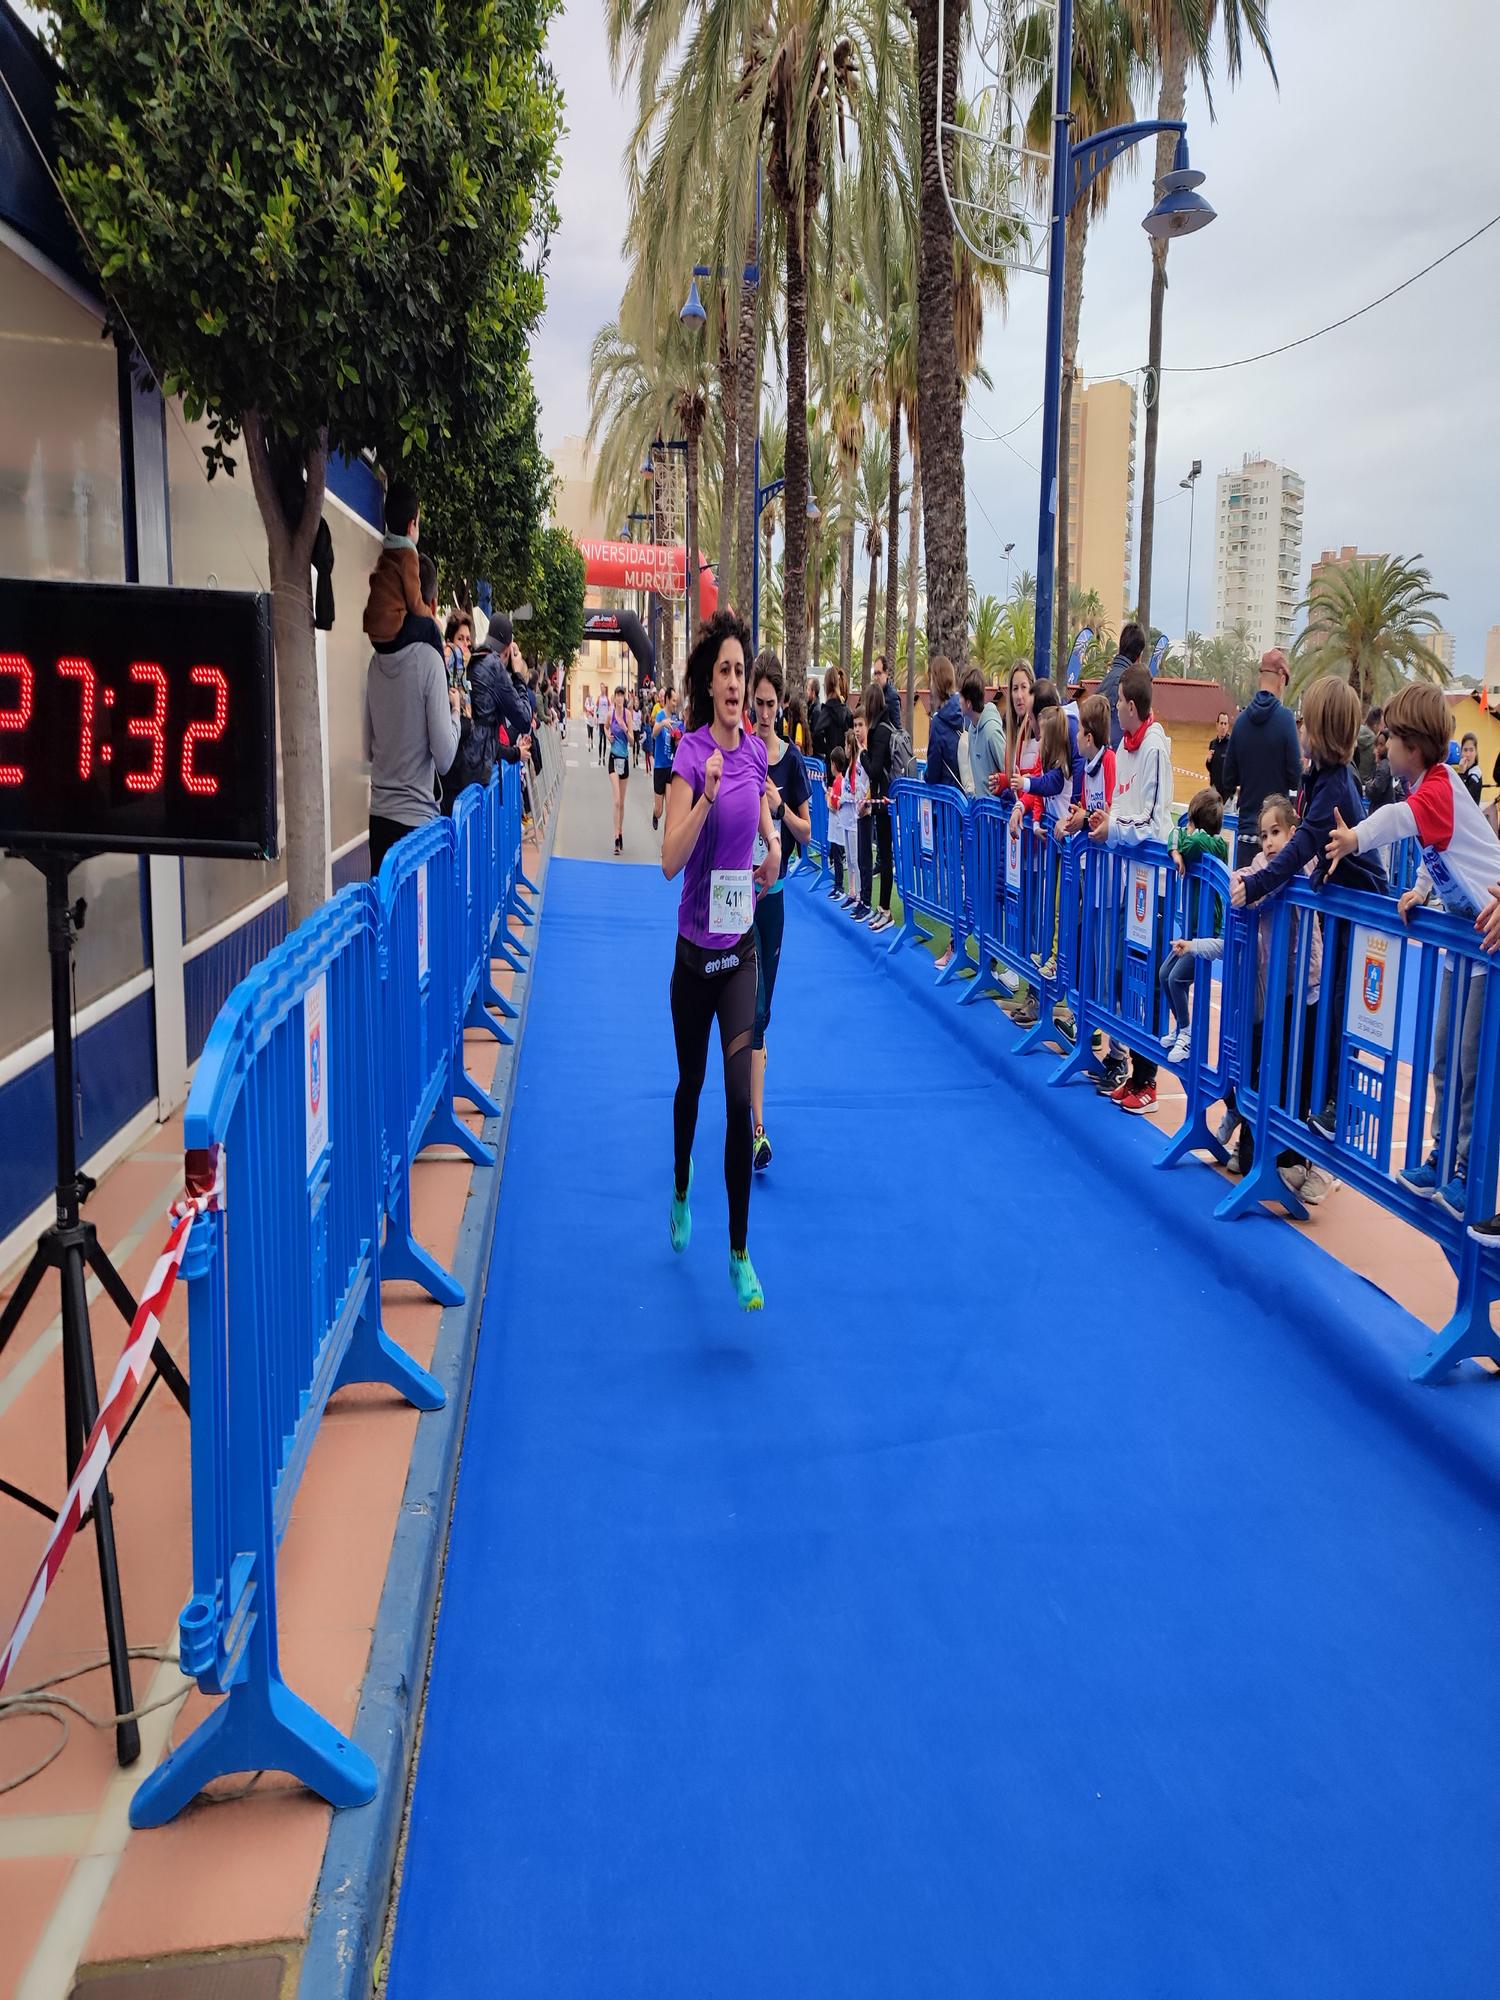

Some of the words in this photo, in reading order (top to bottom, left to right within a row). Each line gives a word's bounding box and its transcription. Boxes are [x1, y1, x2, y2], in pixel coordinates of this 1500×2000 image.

[581, 543, 655, 565] NIVERSIDAD
[658, 549, 675, 567] DE
[624, 570, 676, 593] MURCIA
[0, 654, 229, 794] 27:32
[725, 891, 742, 908] 411
